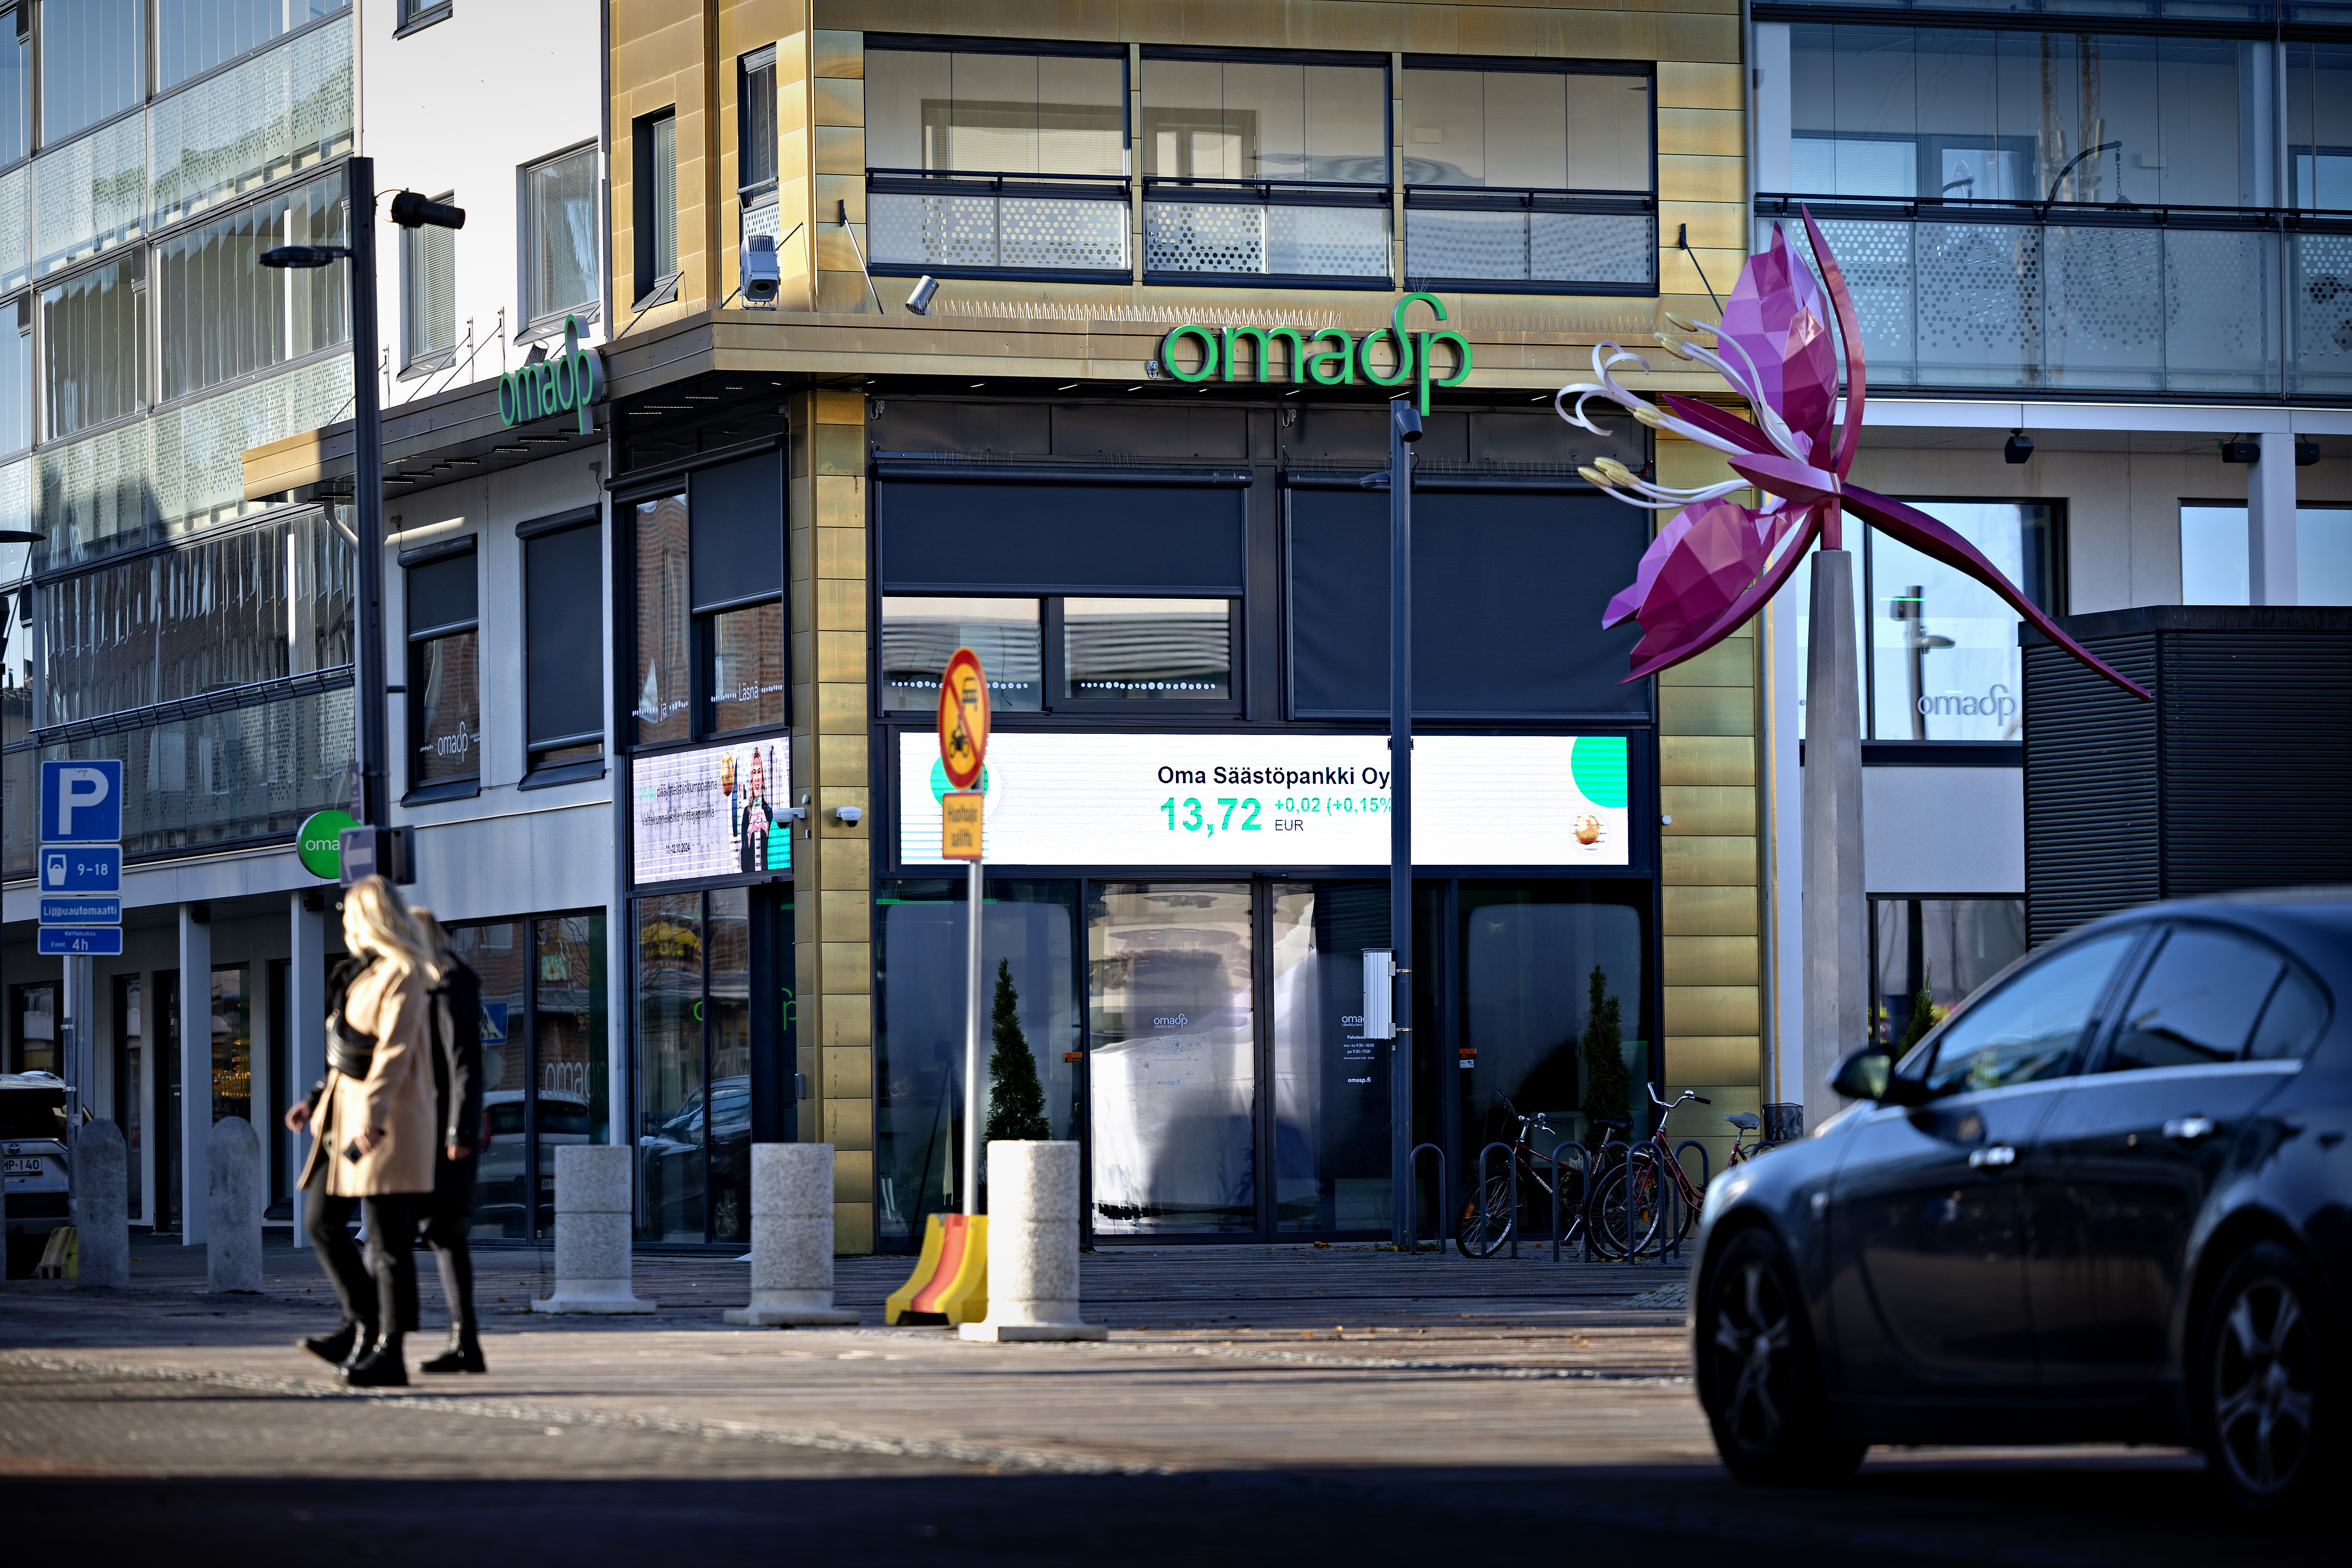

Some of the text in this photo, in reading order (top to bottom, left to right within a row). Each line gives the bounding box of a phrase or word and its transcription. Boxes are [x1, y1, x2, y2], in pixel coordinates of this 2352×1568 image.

[660, 681, 759, 721] ja Läsnä
[1158, 766, 1392, 789] Oma Säästöpankki Oy
[657, 777, 717, 802] pääyhteistyökumppanina
[59, 768, 109, 835] P
[641, 804, 714, 826] Valtakunnallisilla yrittäjäpäivillä
[1160, 797, 1262, 838] 13,72
[1275, 797, 1320, 814] +0,02
[1275, 820, 1304, 831] EUR
[666, 842, 690, 854] 11.-12.10.2024
[77, 864, 108, 876] 9-18
[44, 906, 117, 917] Lippuautomaatti
[1593, 1153, 1603, 1174] HELKAMA
[1536, 1176, 1553, 1194] POWER
